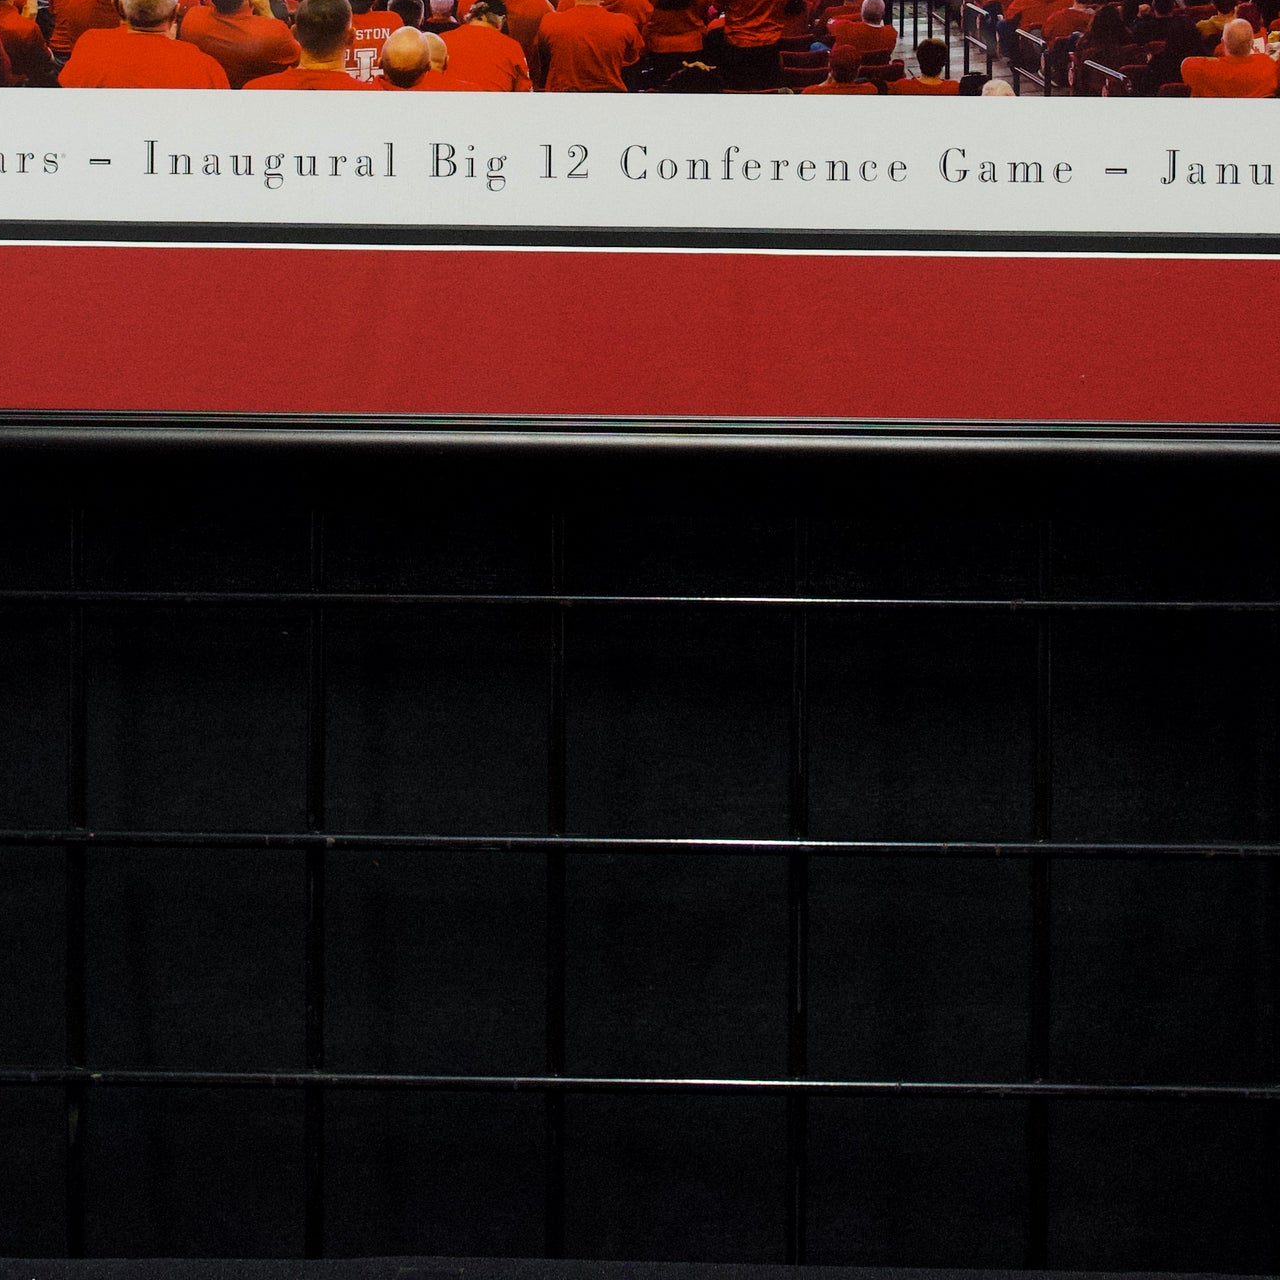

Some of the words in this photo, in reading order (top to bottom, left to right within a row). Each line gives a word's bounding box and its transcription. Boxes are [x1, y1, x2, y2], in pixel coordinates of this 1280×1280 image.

[355, 27, 390, 41] STON
[143, 139, 397, 190] Inaugural
[428, 142, 508, 193] Big
[539, 143, 589, 179] 12
[619, 144, 908, 183] Conference
[938, 147, 1073, 184] Game
